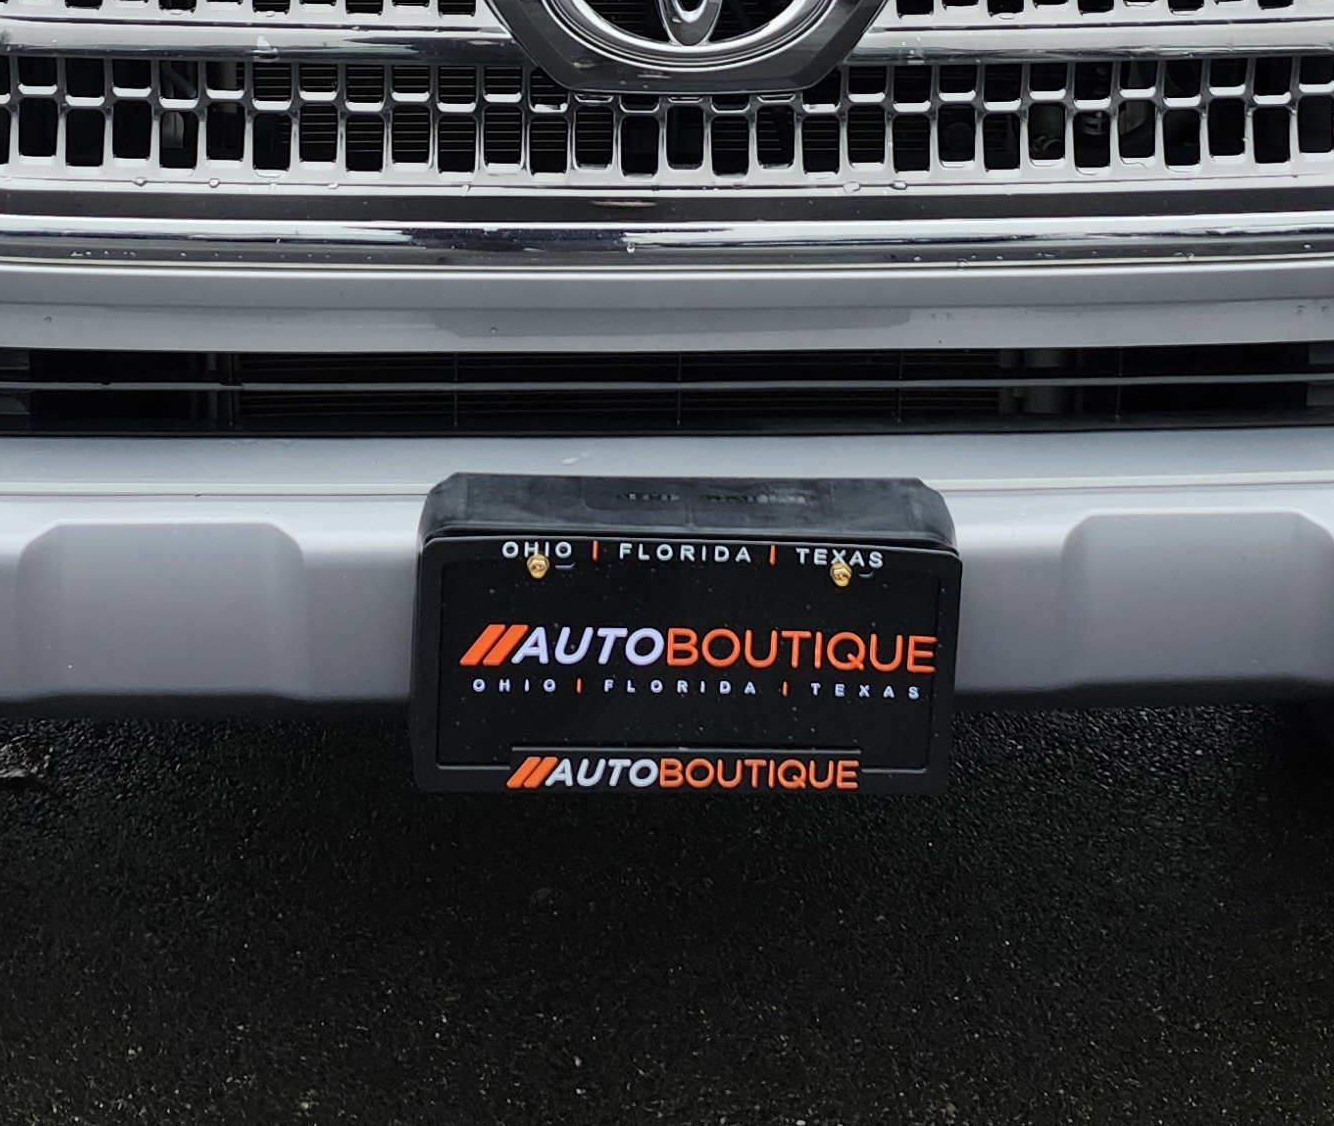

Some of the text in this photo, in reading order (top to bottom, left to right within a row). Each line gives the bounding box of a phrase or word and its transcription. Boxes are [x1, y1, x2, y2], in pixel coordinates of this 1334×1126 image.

[501, 540, 885, 569] OHIO FLORIDA TEXAS
[511, 625, 937, 674] AUTOBOUTIQUE
[472, 678, 920, 701] OHIO FLORIDA TEXAS
[543, 757, 860, 790] AUTOBOUTIQUE
